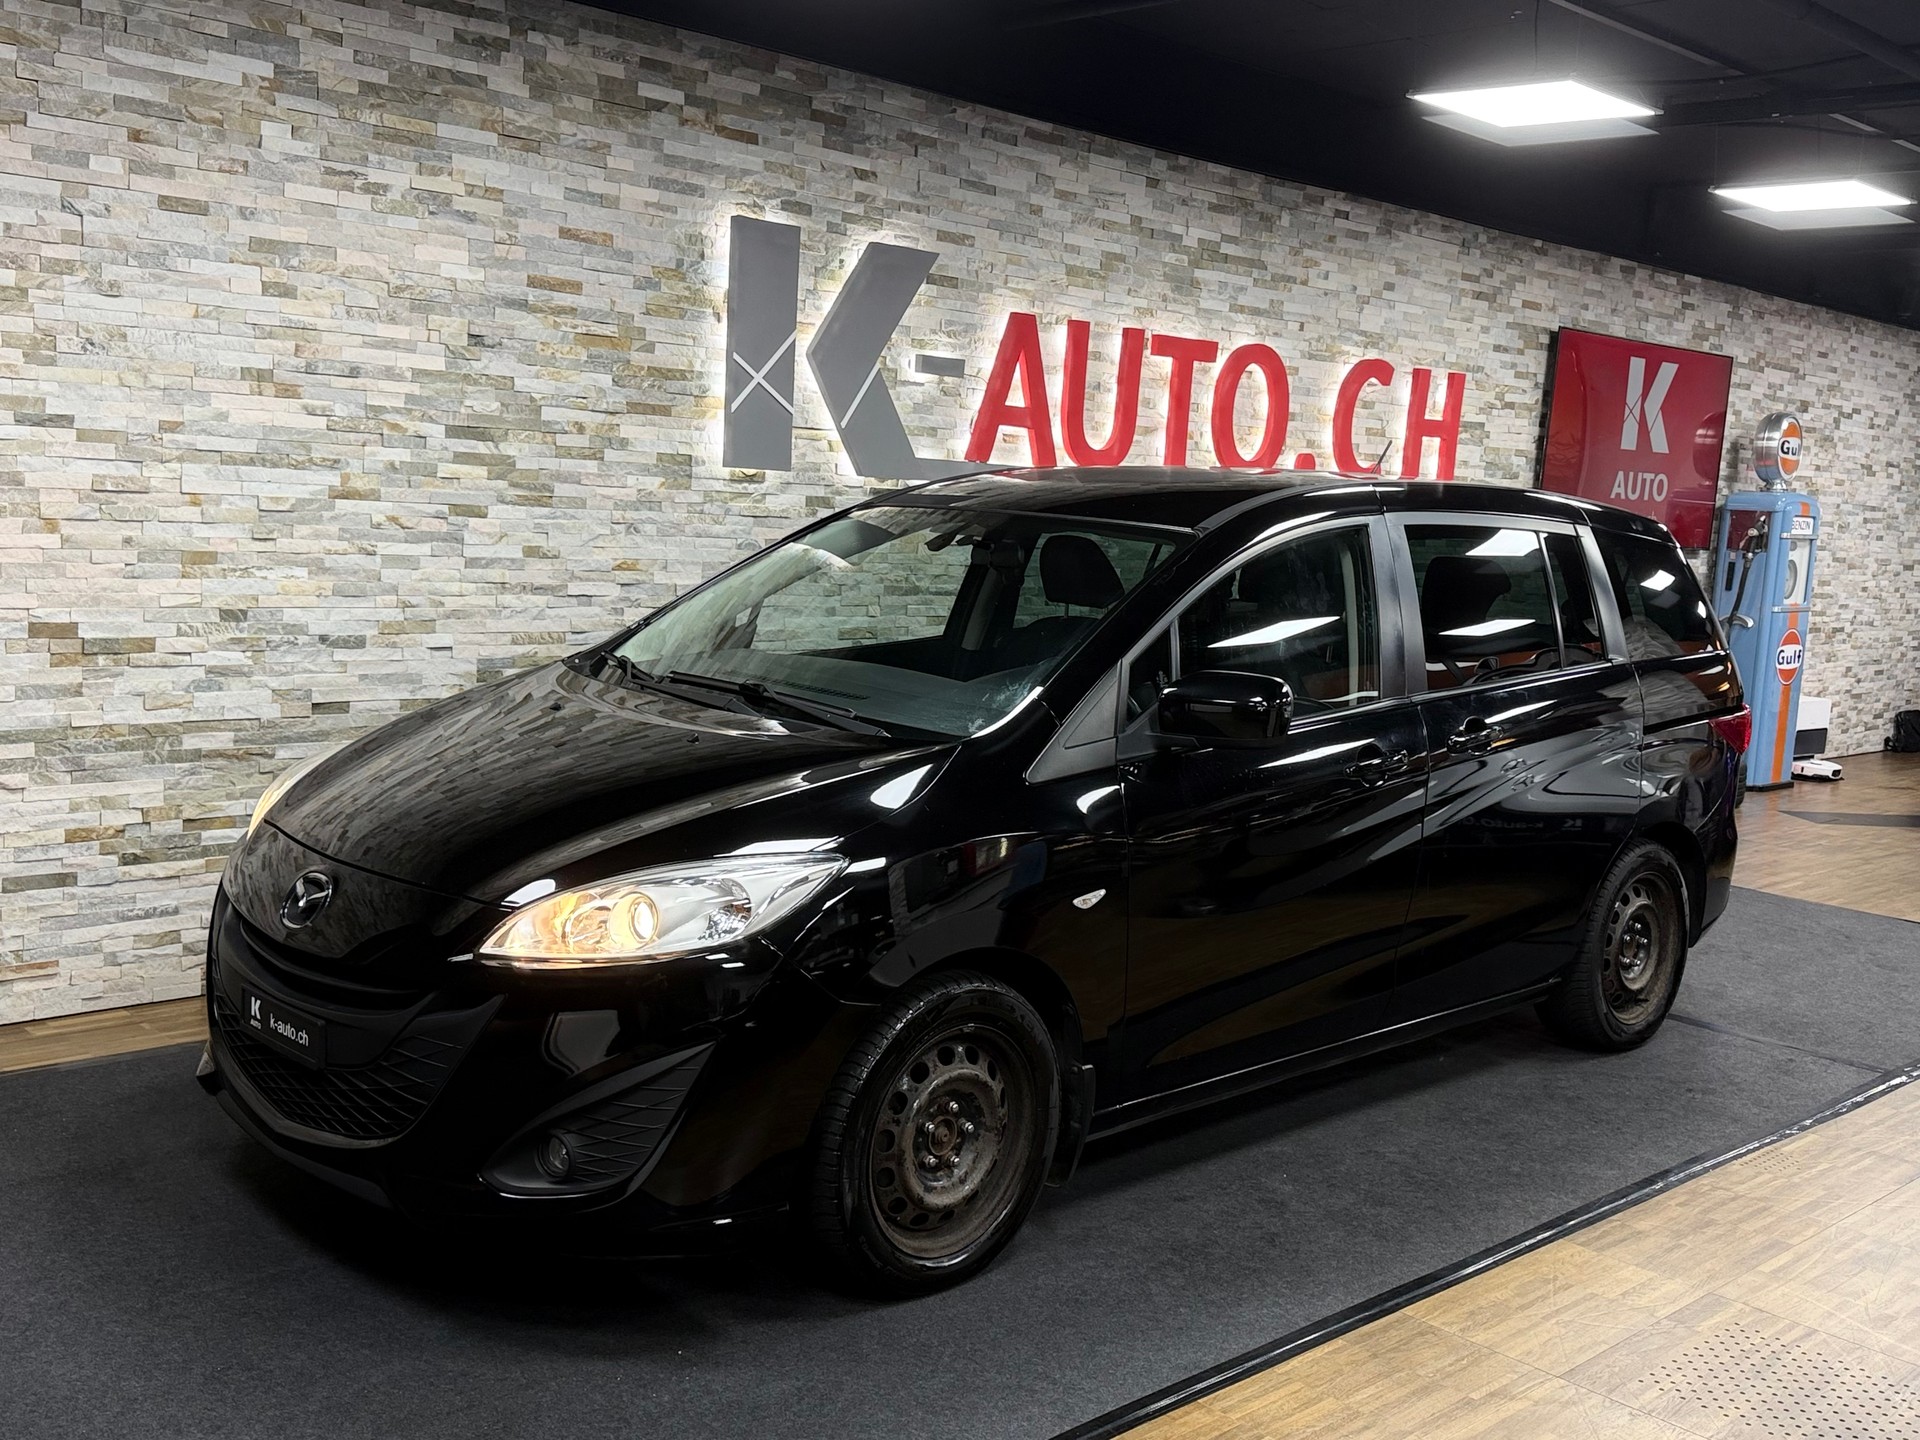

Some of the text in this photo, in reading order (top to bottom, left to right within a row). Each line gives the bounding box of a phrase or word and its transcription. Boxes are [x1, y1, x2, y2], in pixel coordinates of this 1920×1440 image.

[1620, 356, 1679, 454] K
[1610, 471, 1669, 502] AUTO
[1777, 649, 1802, 665] Gulf
[251, 996, 262, 1020] K
[269, 1012, 309, 1047] k-auto.ch
